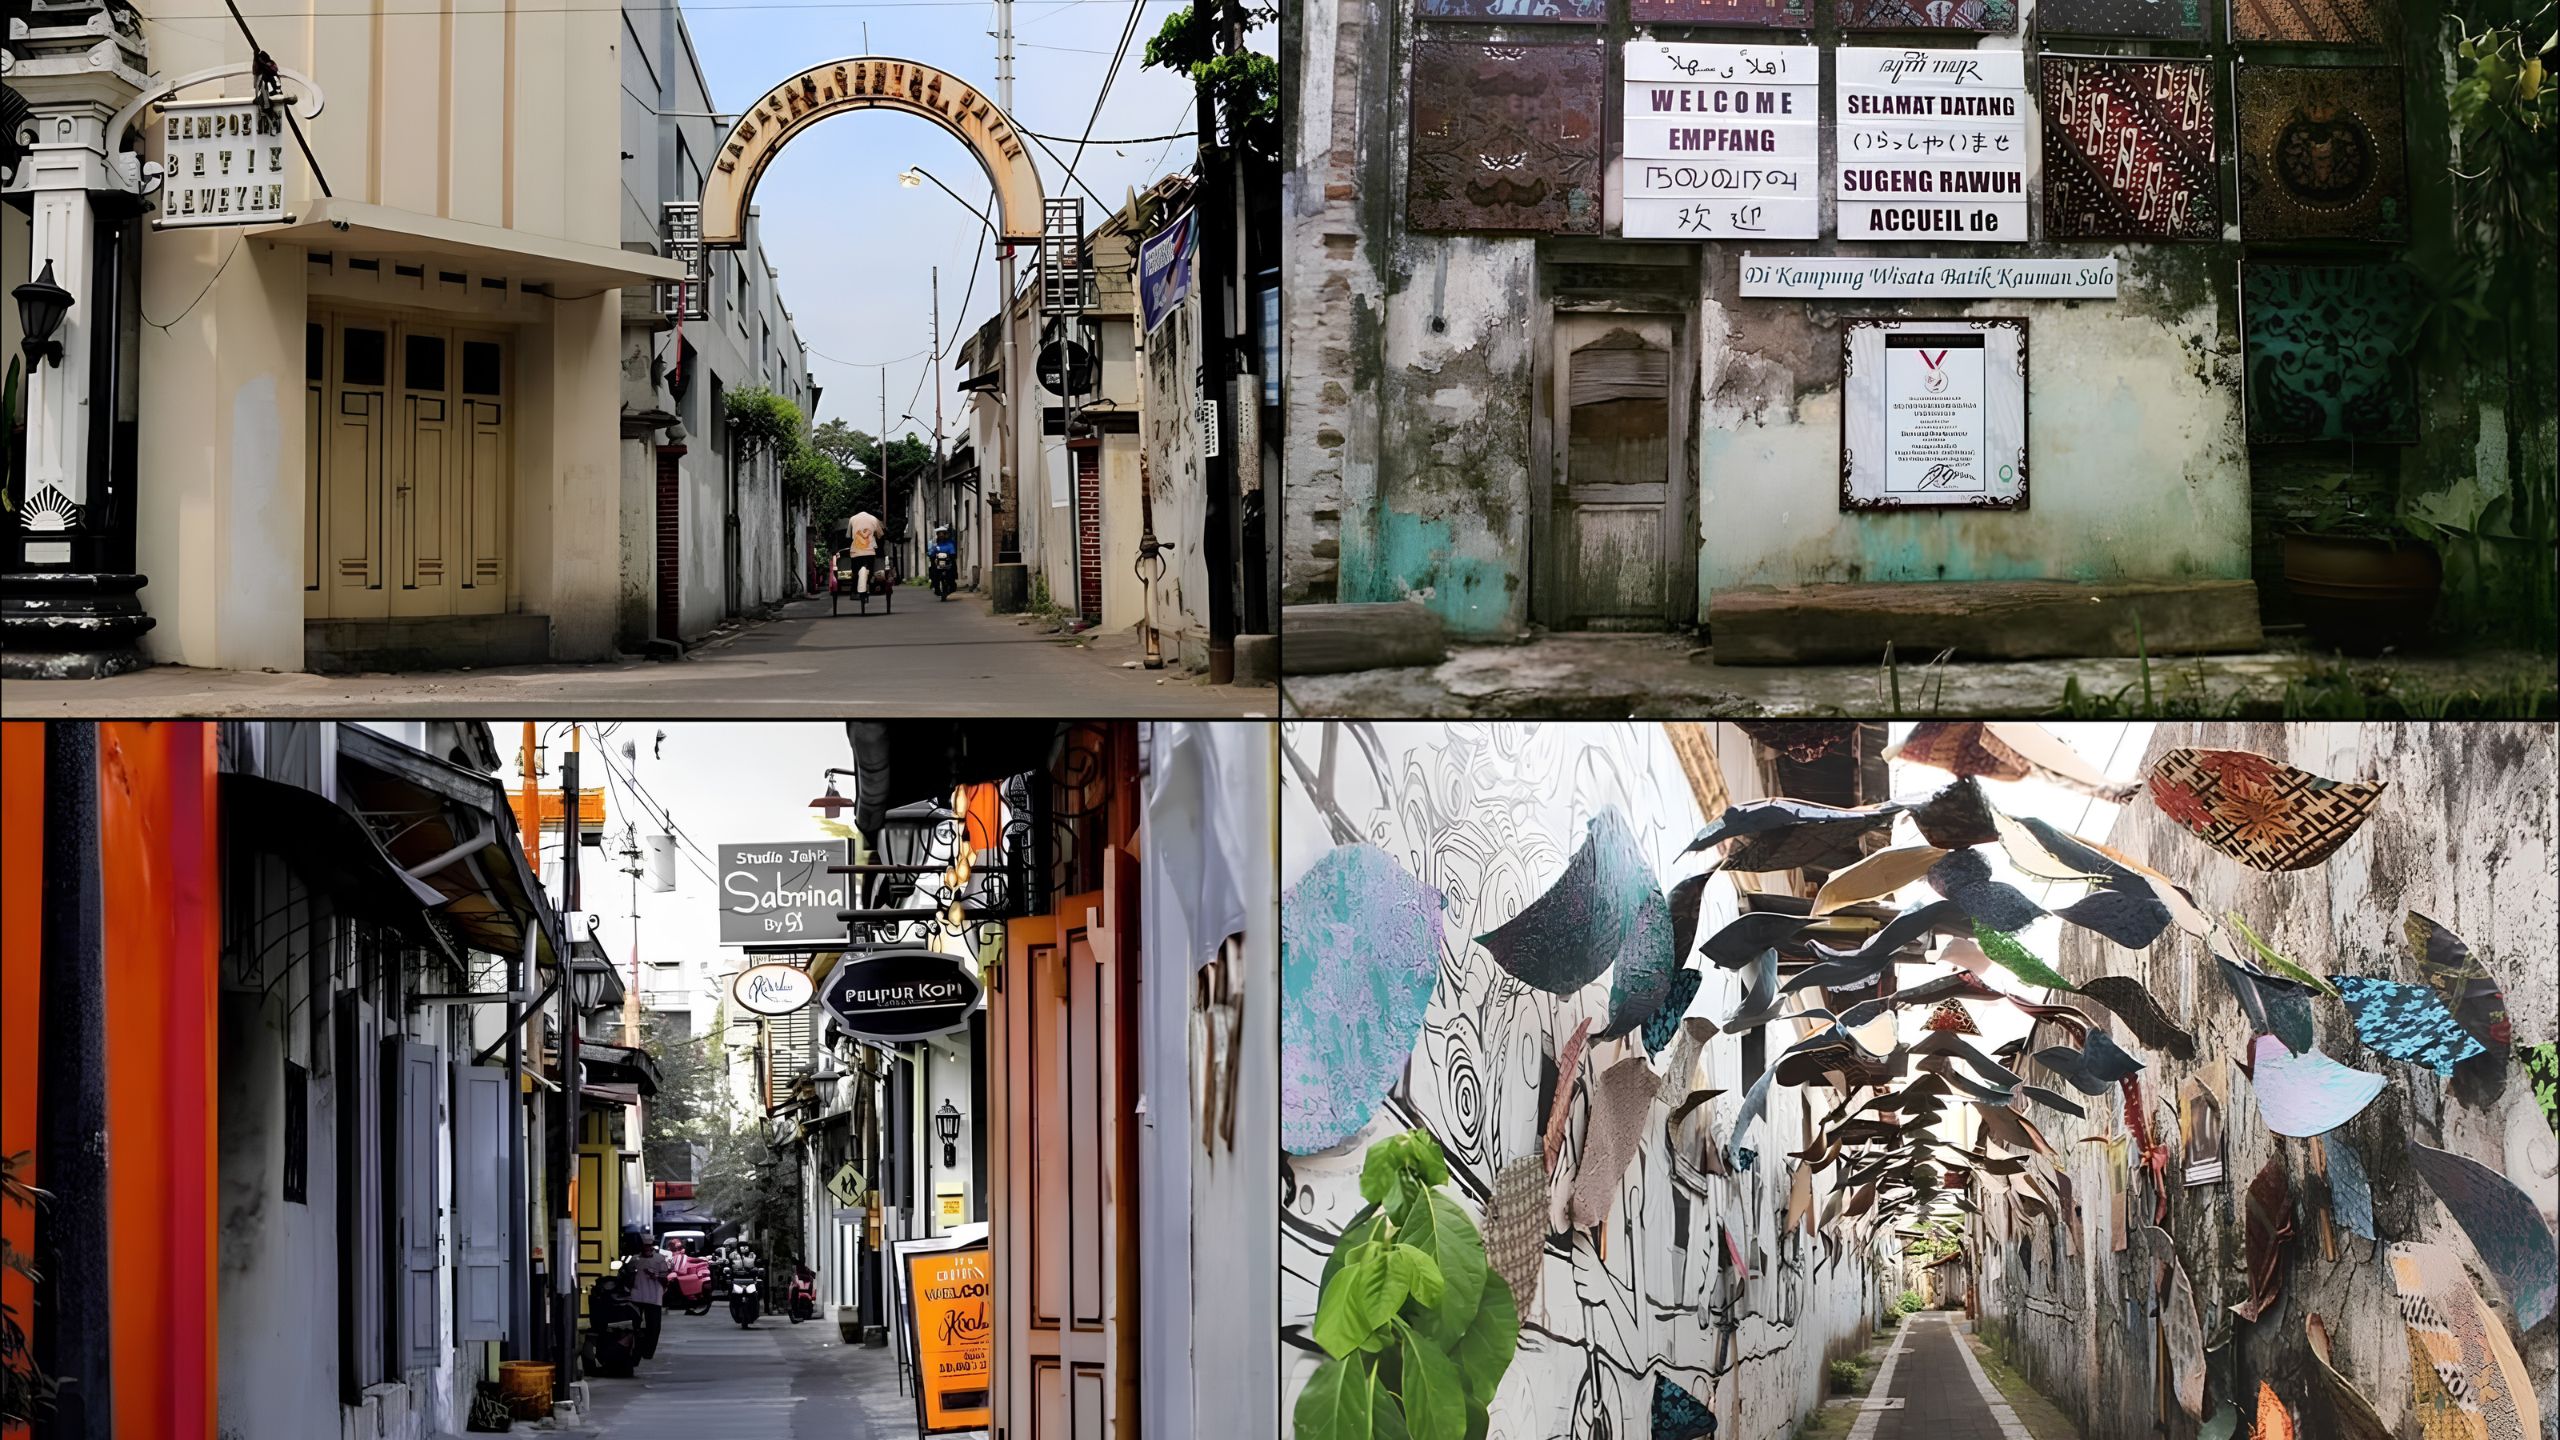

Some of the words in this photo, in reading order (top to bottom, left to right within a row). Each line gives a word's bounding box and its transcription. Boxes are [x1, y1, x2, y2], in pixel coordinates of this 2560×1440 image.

[1651, 90, 1793, 115] WELCOME
[1848, 94, 1936, 116] SELAMAT
[1940, 96, 2016, 117] DATANG
[955, 89, 1022, 161] BATIK
[1669, 128, 1776, 153] EMPFANG
[168, 146, 282, 178] BATIK
[1843, 169, 1933, 193] SUGENG
[1939, 170, 2022, 193] RAWUH
[166, 184, 282, 216] LAWEYAN
[1869, 208, 1965, 231] ACCUEIL
[1970, 209, 1999, 232] de
[1745, 266, 1772, 284] Di
[1775, 267, 1864, 291] Kampung
[1869, 265, 1935, 285] Wisata
[1940, 266, 1997, 289] Batik
[1996, 268, 2072, 289] Kauman
[2075, 266, 2114, 287] Solo
[724, 870, 844, 914] Sabrina
[764, 918, 783, 933] By
[918, 983, 963, 999] KOPI
[924, 1283, 990, 1302] WELCO
